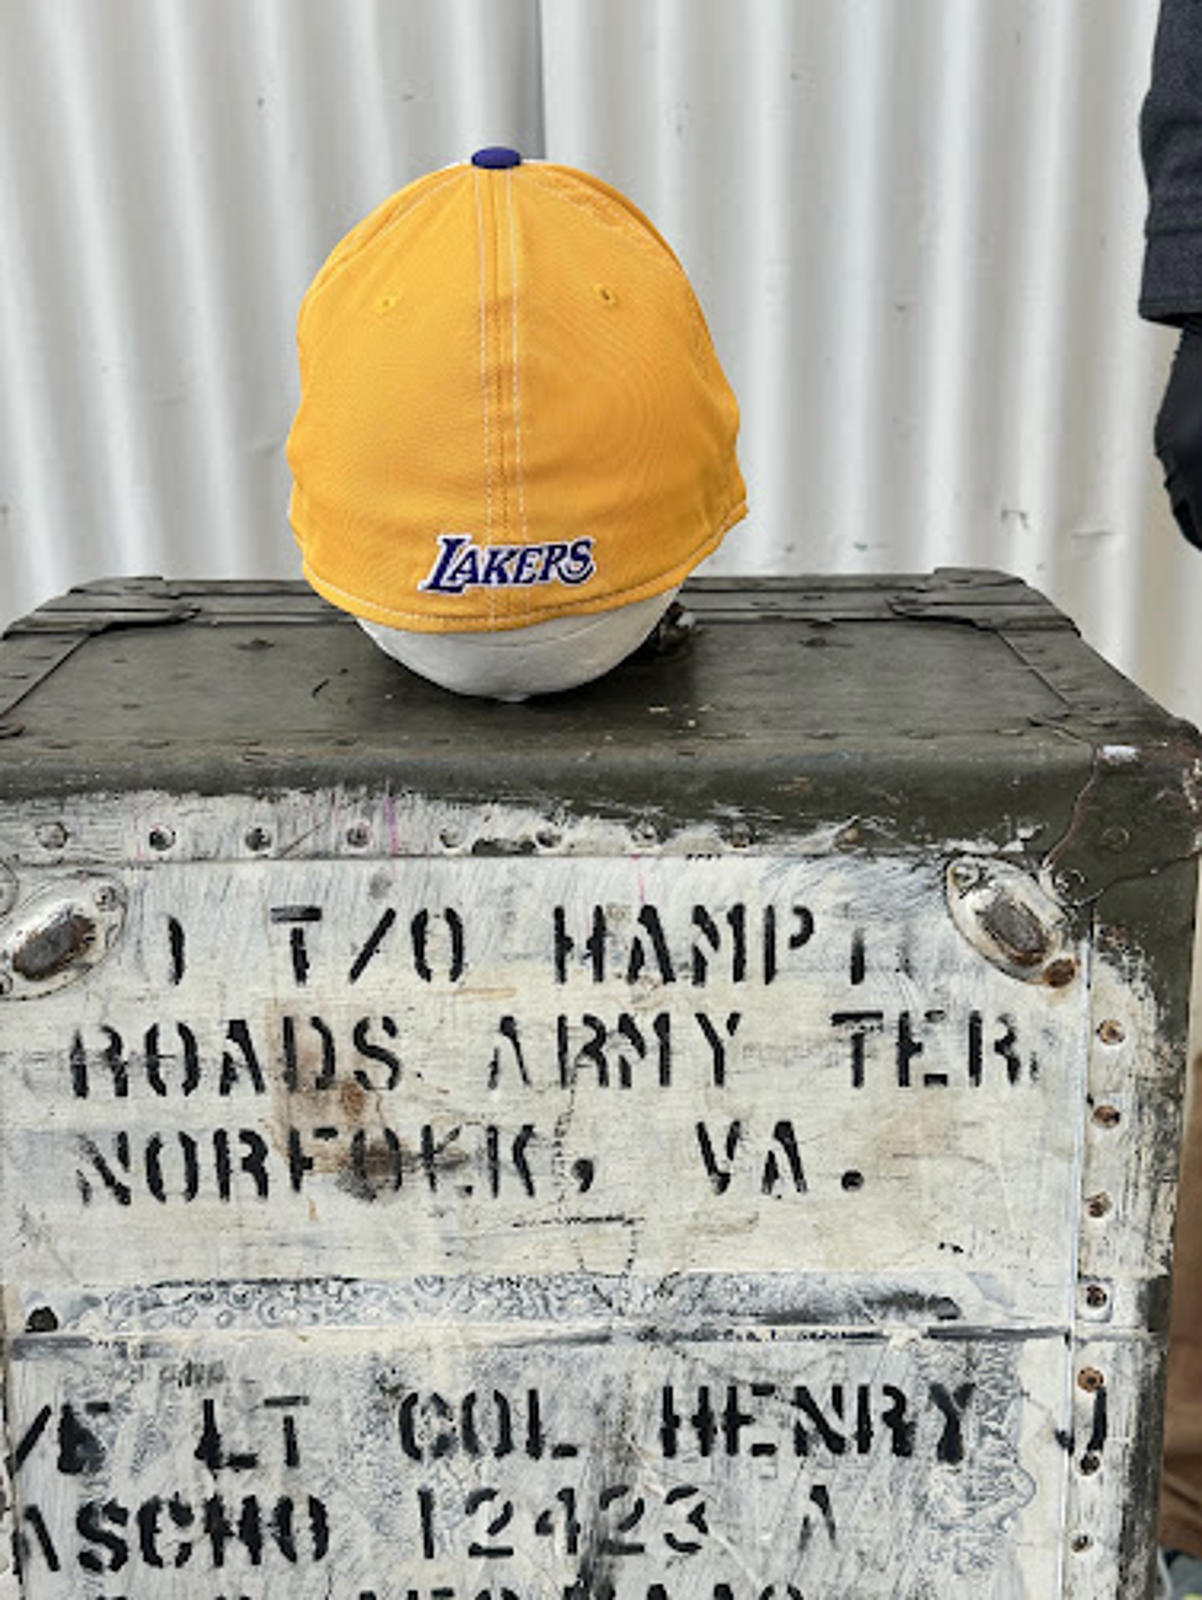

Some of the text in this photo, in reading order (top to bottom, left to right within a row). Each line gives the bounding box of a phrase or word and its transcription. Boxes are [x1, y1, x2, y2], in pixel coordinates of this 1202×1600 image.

[417, 533, 596, 593] LAKERS
[271, 905, 465, 985] T/O
[69, 1015, 402, 1099] ROADS
[488, 1012, 741, 1088] ARMY
[696, 1120, 866, 1198] VA.
[194, 1396, 309, 1469] LT
[399, 1388, 579, 1461] COL
[659, 1383, 976, 1464] HENRY
[416, 1486, 708, 1560] 12423
